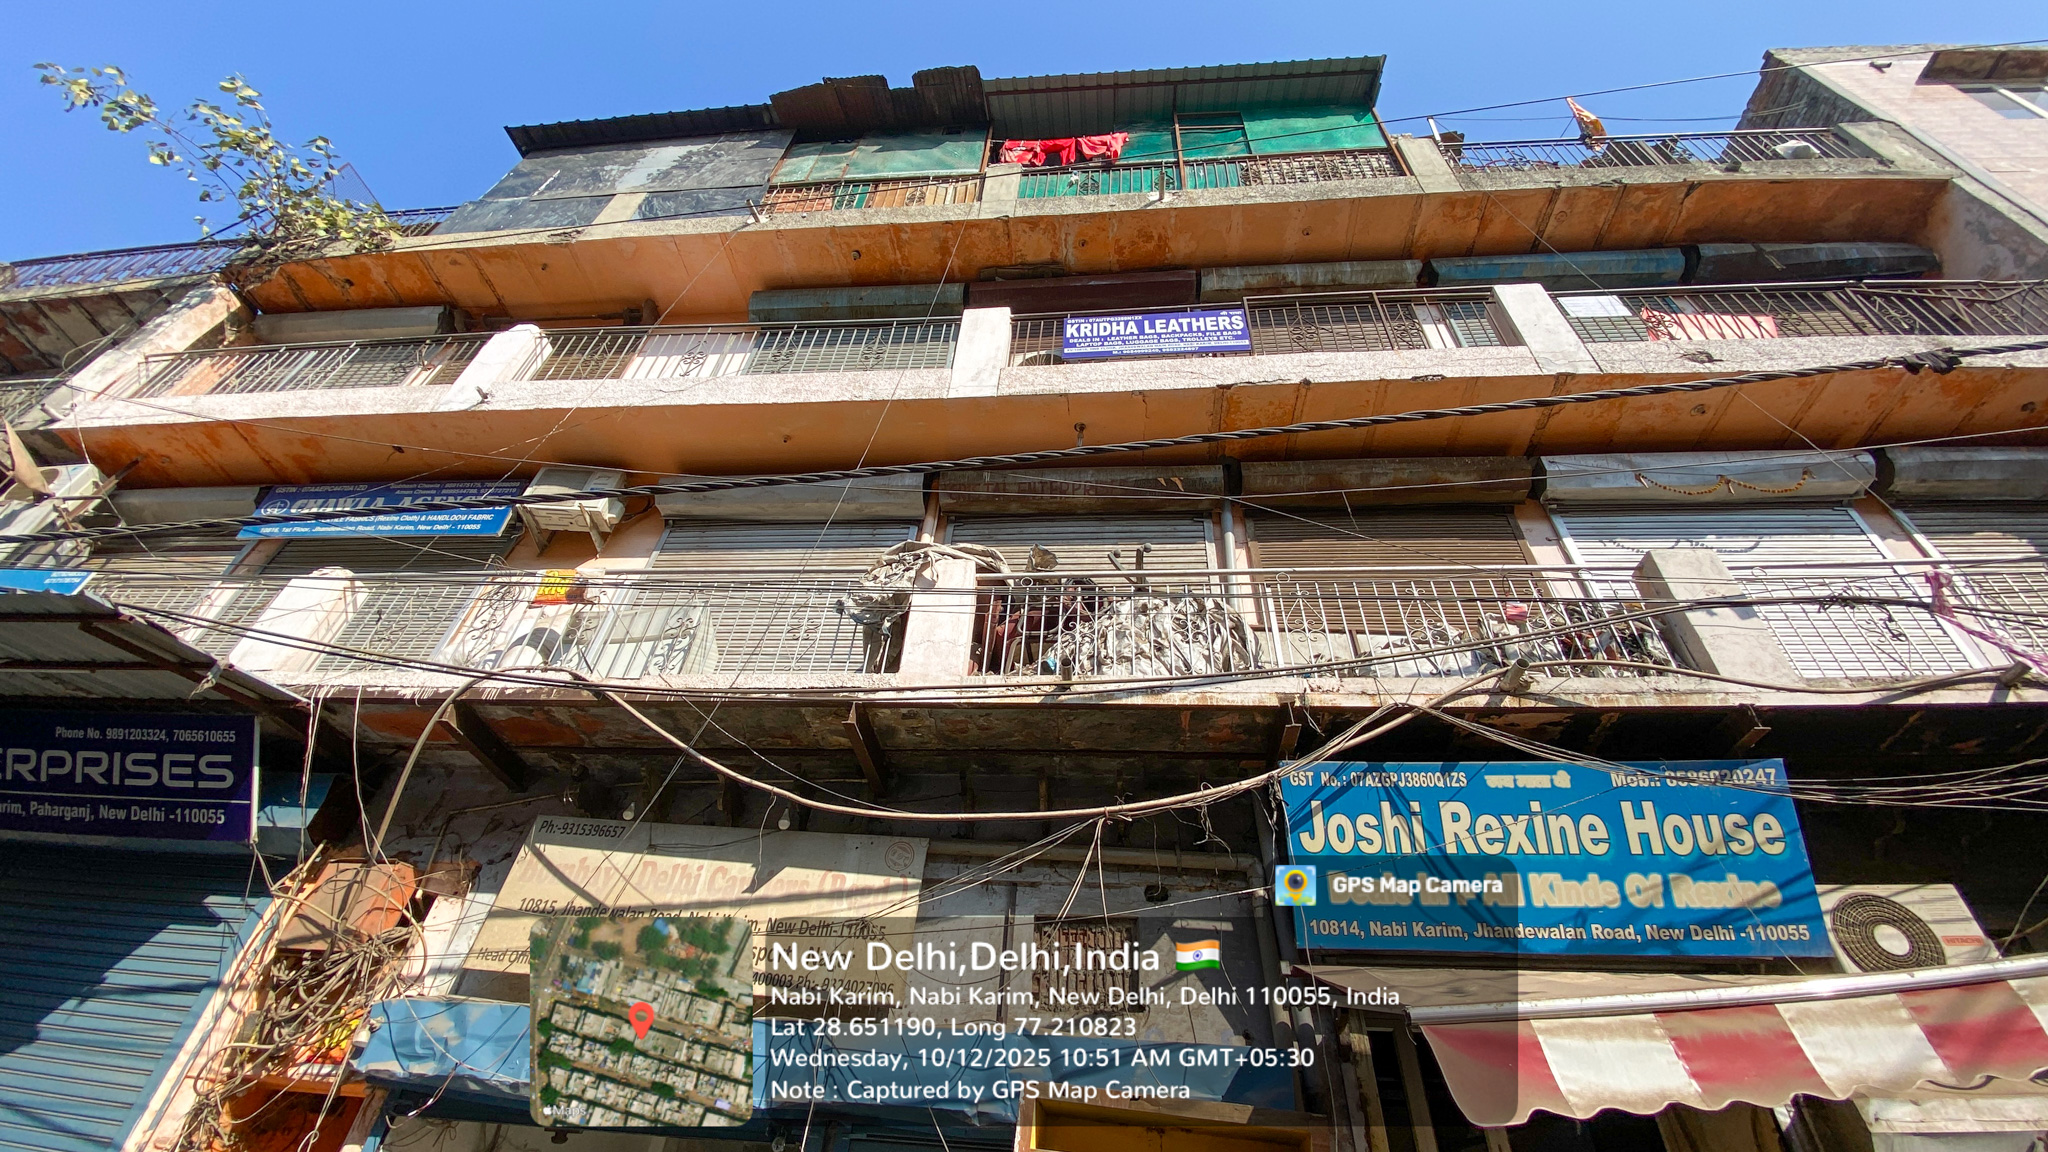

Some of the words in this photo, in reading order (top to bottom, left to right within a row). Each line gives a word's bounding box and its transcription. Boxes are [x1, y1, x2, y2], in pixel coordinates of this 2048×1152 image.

[1066, 320, 1139, 338] KRIDHA
[1143, 315, 1244, 335] LEATHERS
[290, 497, 384, 514] CHAWLA
[345, 515, 375, 523] FABRICS
[374, 515, 399, 523] (Rexine
[399, 514, 420, 522] Cloth)
[467, 513, 495, 521] FABRIC
[55, 727, 84, 739] Phone
[87, 727, 103, 740] No.
[106, 728, 170, 743] 9891203324,
[173, 730, 237, 743] 7065610655
[0, 748, 235, 789] RPRISES
[1289, 771, 1313, 787] GST
[1610, 771, 1661, 788] Mob.:
[30, 801, 95, 822] Paharganj,
[99, 805, 127, 820] New
[131, 806, 165, 823] Delhi
[169, 808, 226, 825] -110055
[539, 820, 626, 839] Ph:-9315396657
[1297, 800, 1425, 855] Joshi
[1438, 799, 1610, 856] Rexine
[1619, 800, 1786, 856] House
[634, 860, 704, 896] Delhi
[1528, 872, 1622, 909] Kinds
[1624, 872, 1664, 909] Of
[1668, 872, 1783, 910] Rexine
[518, 898, 559, 918] 10815,
[766, 918, 797, 932] New
[1309, 919, 1365, 939] 10814,
[1369, 920, 1408, 938] Nabi
[1412, 920, 1469, 941] Karim,
[1473, 921, 1587, 942] Jhandewalan
[1591, 923, 1642, 944] Road,
[1645, 924, 1684, 941] New
[1690, 924, 1736, 942] Delhi
[1739, 925, 1811, 943] -110055
[1945, 937, 1982, 945] HITACHI
[476, 947, 507, 963] Head
